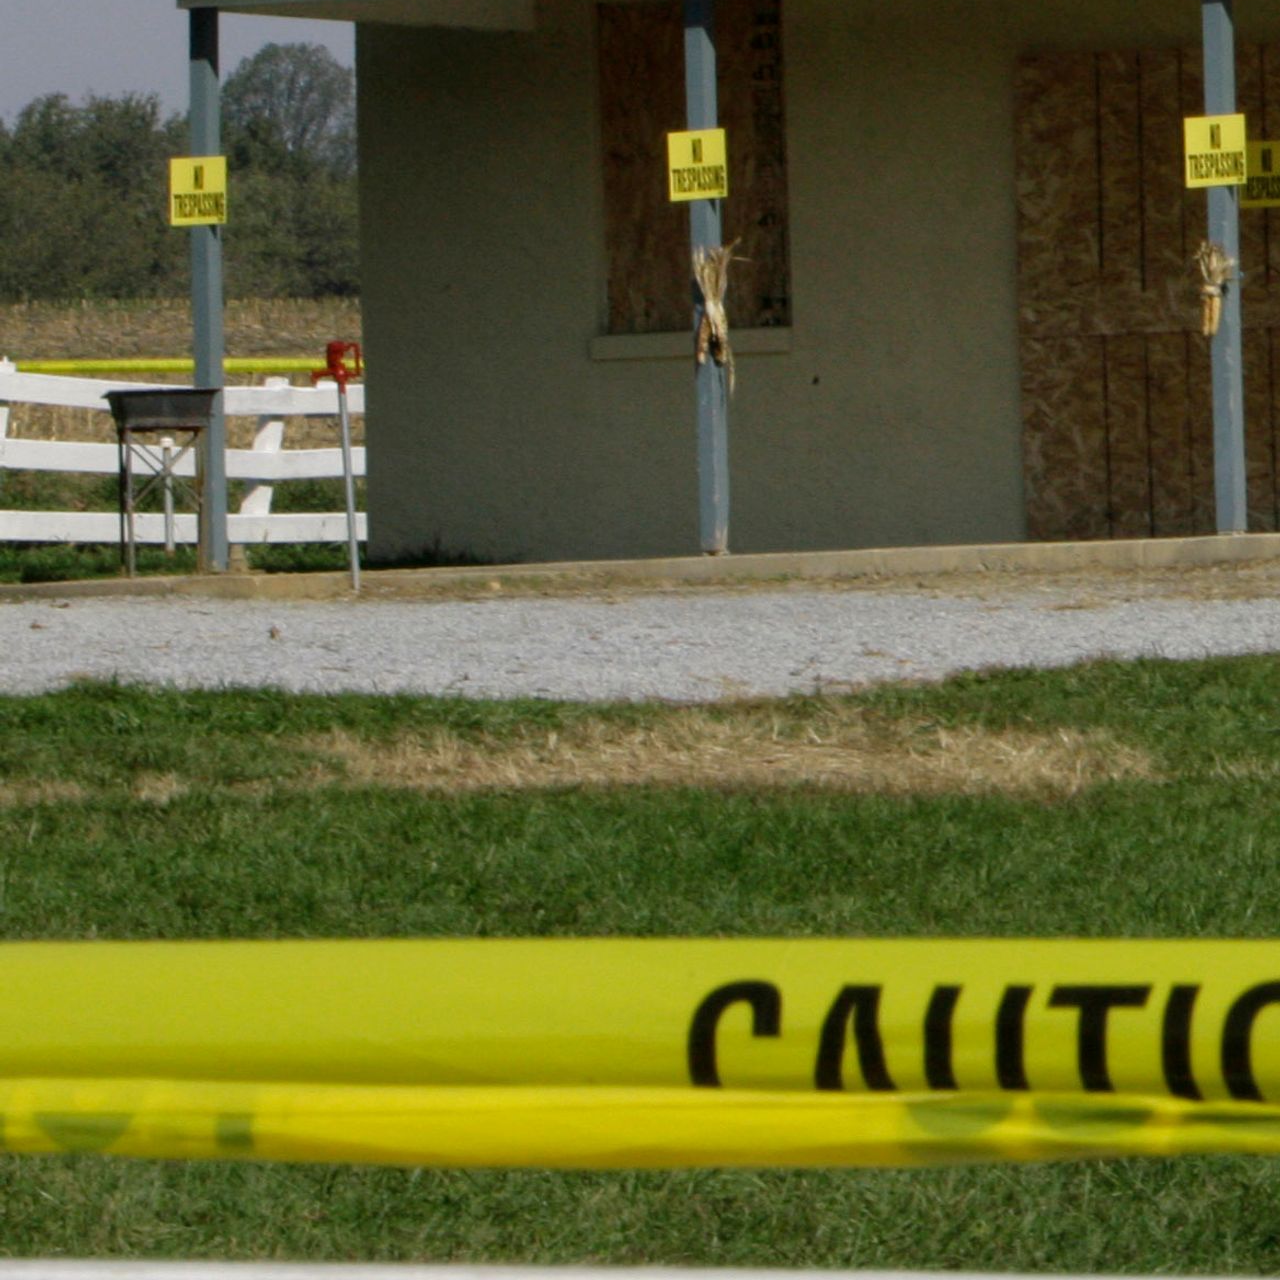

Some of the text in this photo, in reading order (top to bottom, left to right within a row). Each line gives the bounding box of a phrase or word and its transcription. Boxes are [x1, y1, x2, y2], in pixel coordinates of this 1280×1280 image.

[1209, 123, 1221, 150] NO
[691, 138, 703, 164] NO
[1261, 148, 1272, 173] NO
[193, 165, 204, 190] NO
[1188, 151, 1244, 179] TRESPASSING
[672, 165, 724, 193] TRESPASSING
[173, 192, 225, 219] TRESPASSING
